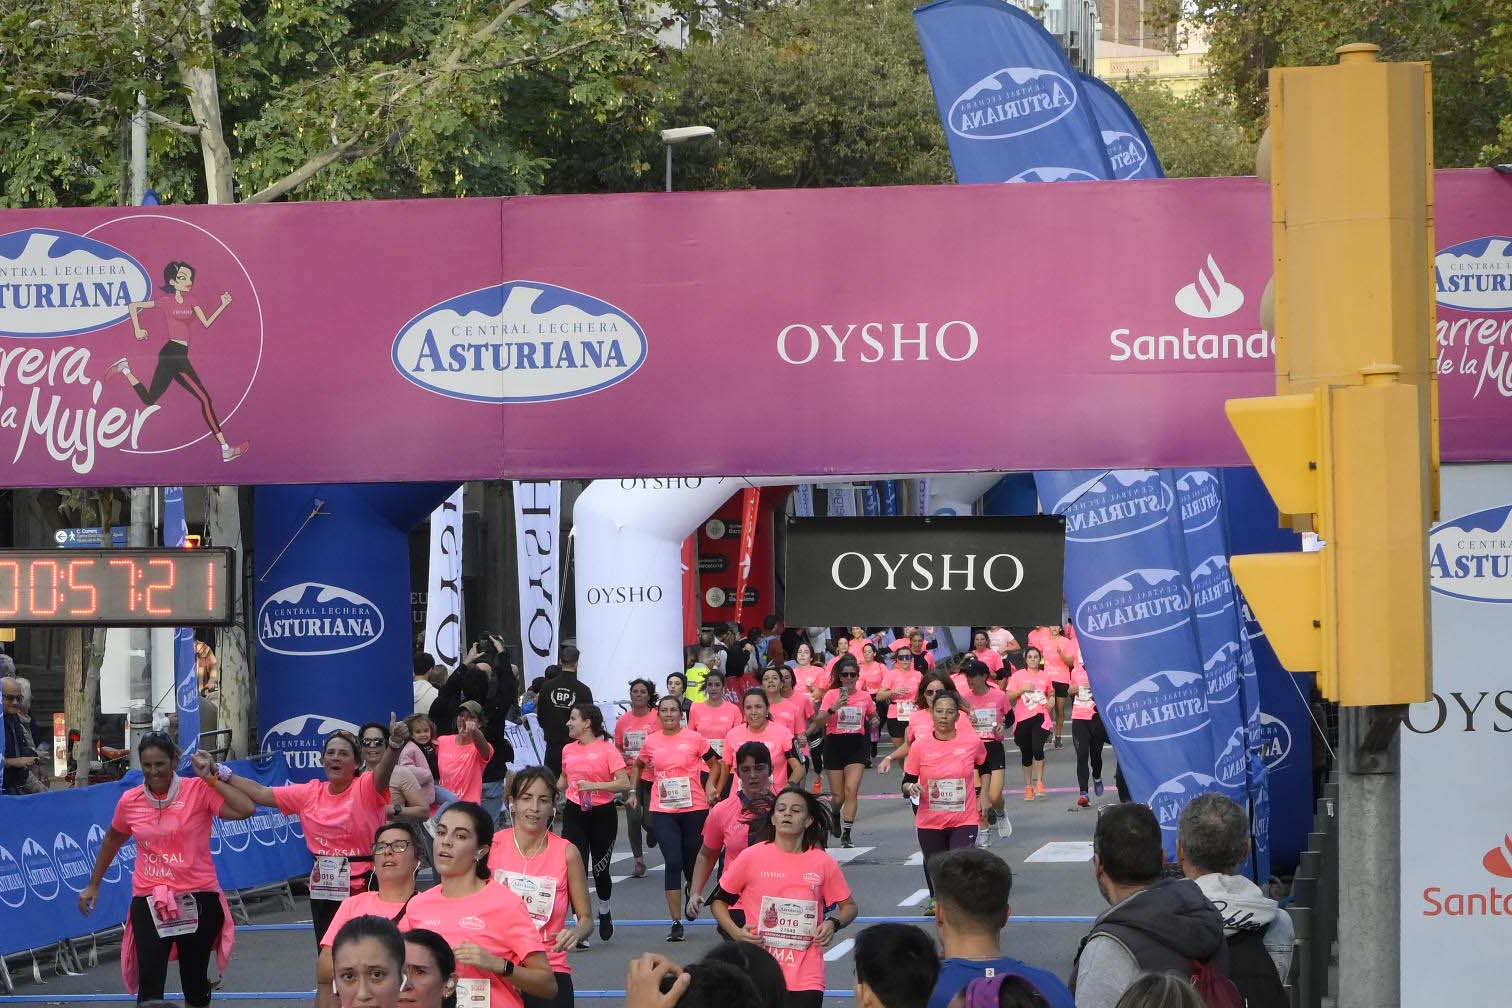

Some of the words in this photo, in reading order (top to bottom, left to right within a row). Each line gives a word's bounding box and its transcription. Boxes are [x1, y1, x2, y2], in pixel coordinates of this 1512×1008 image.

[55, 265, 126, 276] LECHERA
[452, 324, 530, 336] CENTRAL
[539, 322, 618, 334] LECHERA
[777, 320, 978, 364] OYSHO
[1436, 318, 1512, 346] arrer
[413, 329, 627, 373] ASTURIANA
[1460, 347, 1478, 374] la
[13, 380, 161, 474] Mujer
[832, 552, 1024, 592] OYSHO
[587, 585, 663, 605] OYSHO
[274, 608, 316, 616] CENTRAL
[321, 607, 369, 615] LECHERA
[262, 612, 375, 640] ASTURIANA
[276, 739, 317, 747] CENTRAL
